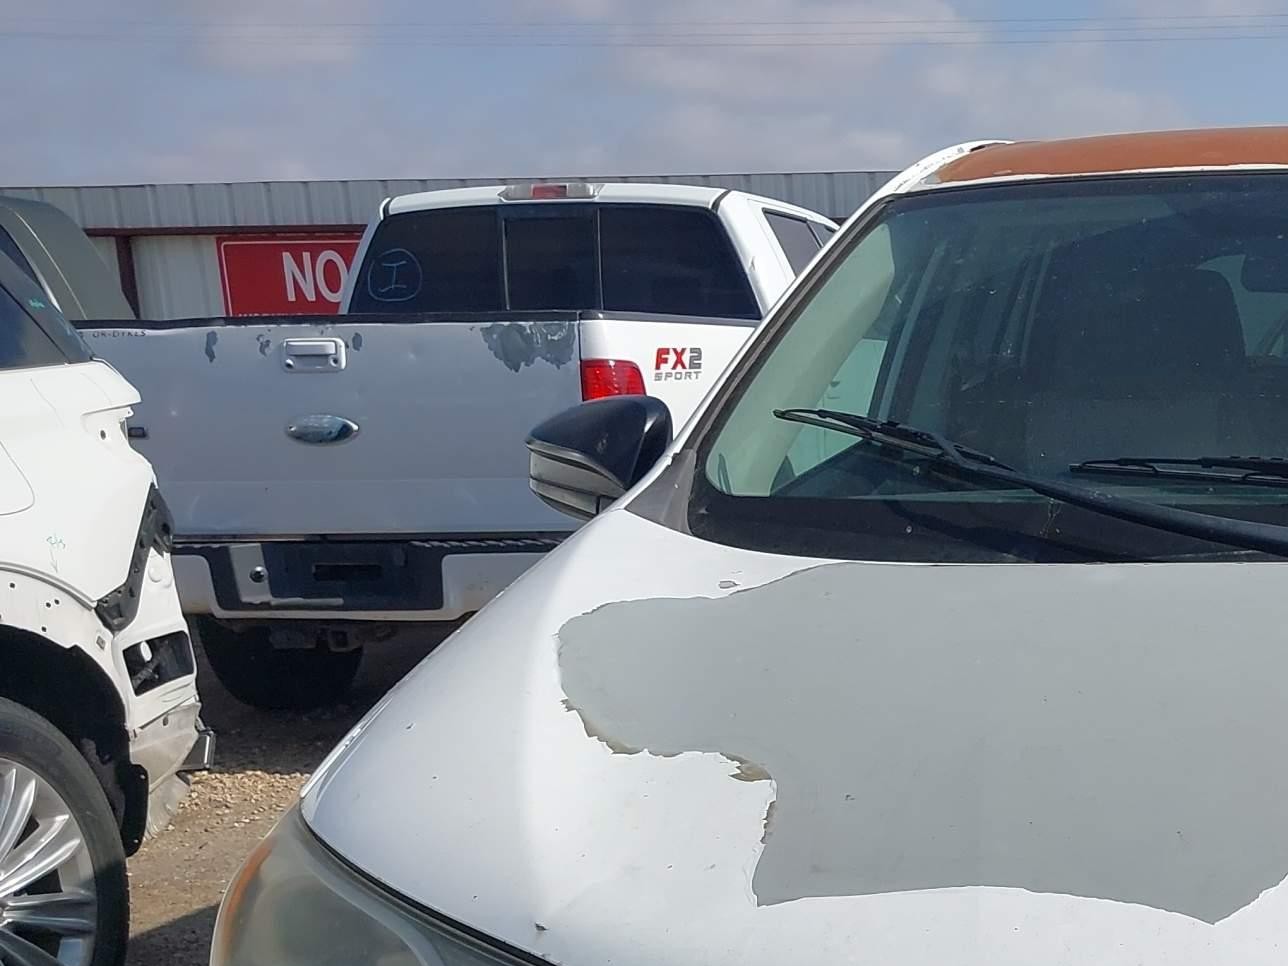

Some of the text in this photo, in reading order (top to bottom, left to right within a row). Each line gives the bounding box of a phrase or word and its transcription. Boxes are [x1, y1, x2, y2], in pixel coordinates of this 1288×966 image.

[282, 249, 349, 303] NO
[655, 347, 703, 371] FX2
[654, 371, 702, 382] SPORT
